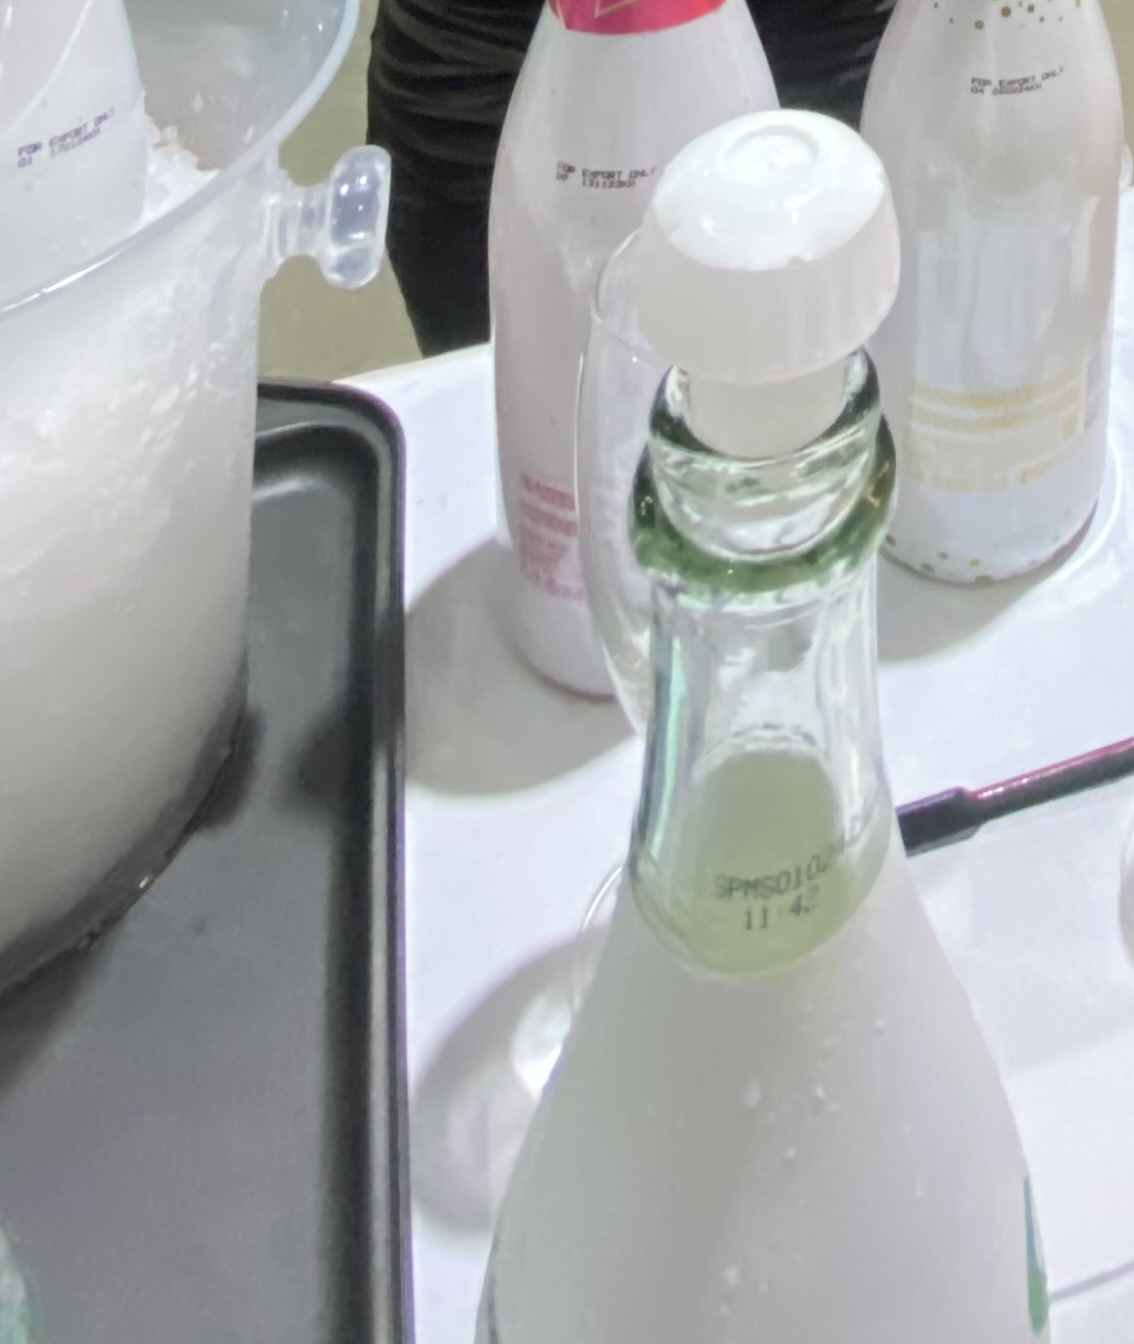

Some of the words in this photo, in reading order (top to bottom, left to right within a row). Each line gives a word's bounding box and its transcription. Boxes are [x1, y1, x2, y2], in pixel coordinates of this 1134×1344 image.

[970, 76, 992, 87] FOR
[999, 75, 1037, 88] EXPORT
[1041, 65, 1065, 81] ONLY
[18, 141, 42, 156] FOR
[49, 122, 88, 147] EXPORT
[557, 161, 576, 173] FOR
[582, 168, 622, 179] EXPORT
[629, 165, 657, 179] ONLY
